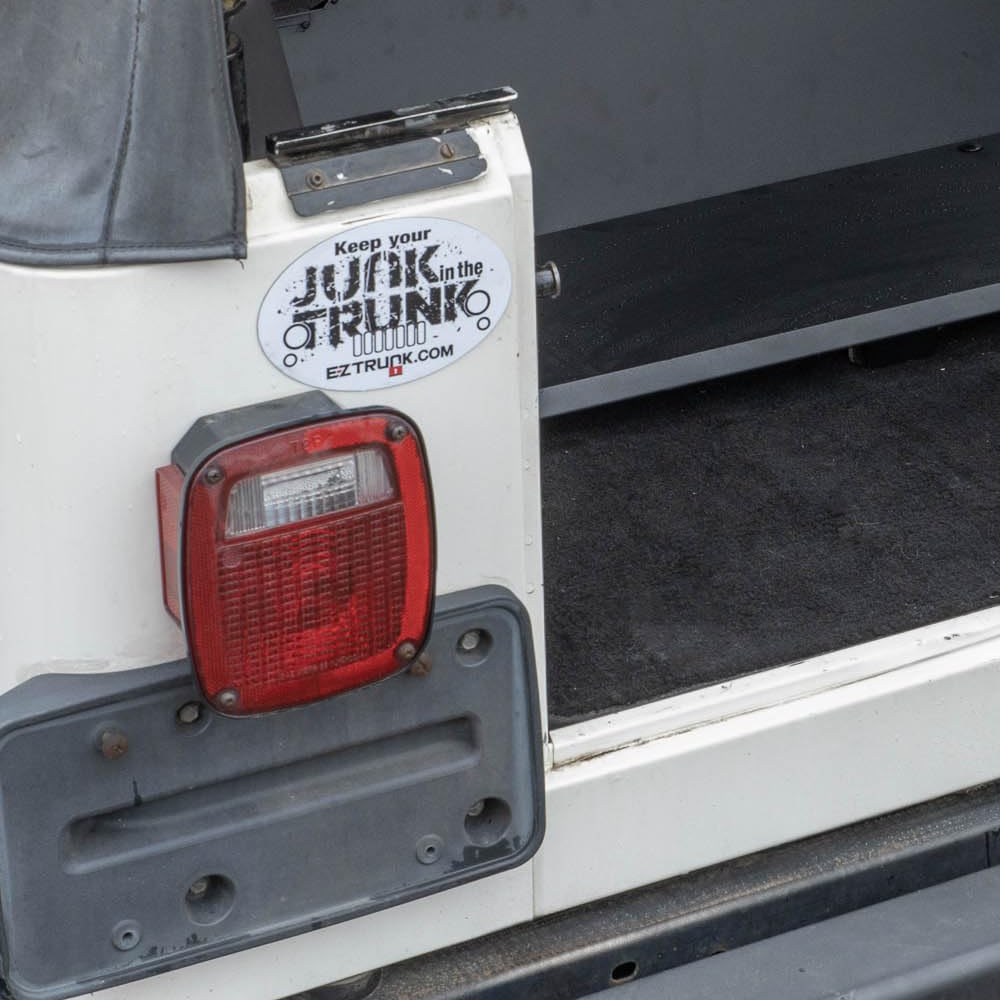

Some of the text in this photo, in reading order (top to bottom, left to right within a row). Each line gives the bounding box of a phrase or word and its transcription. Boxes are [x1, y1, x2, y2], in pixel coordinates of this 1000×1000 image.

[335, 229, 431, 256] Keep your
[290, 244, 483, 307] JUNK in the
[293, 279, 479, 350] TRUNK
